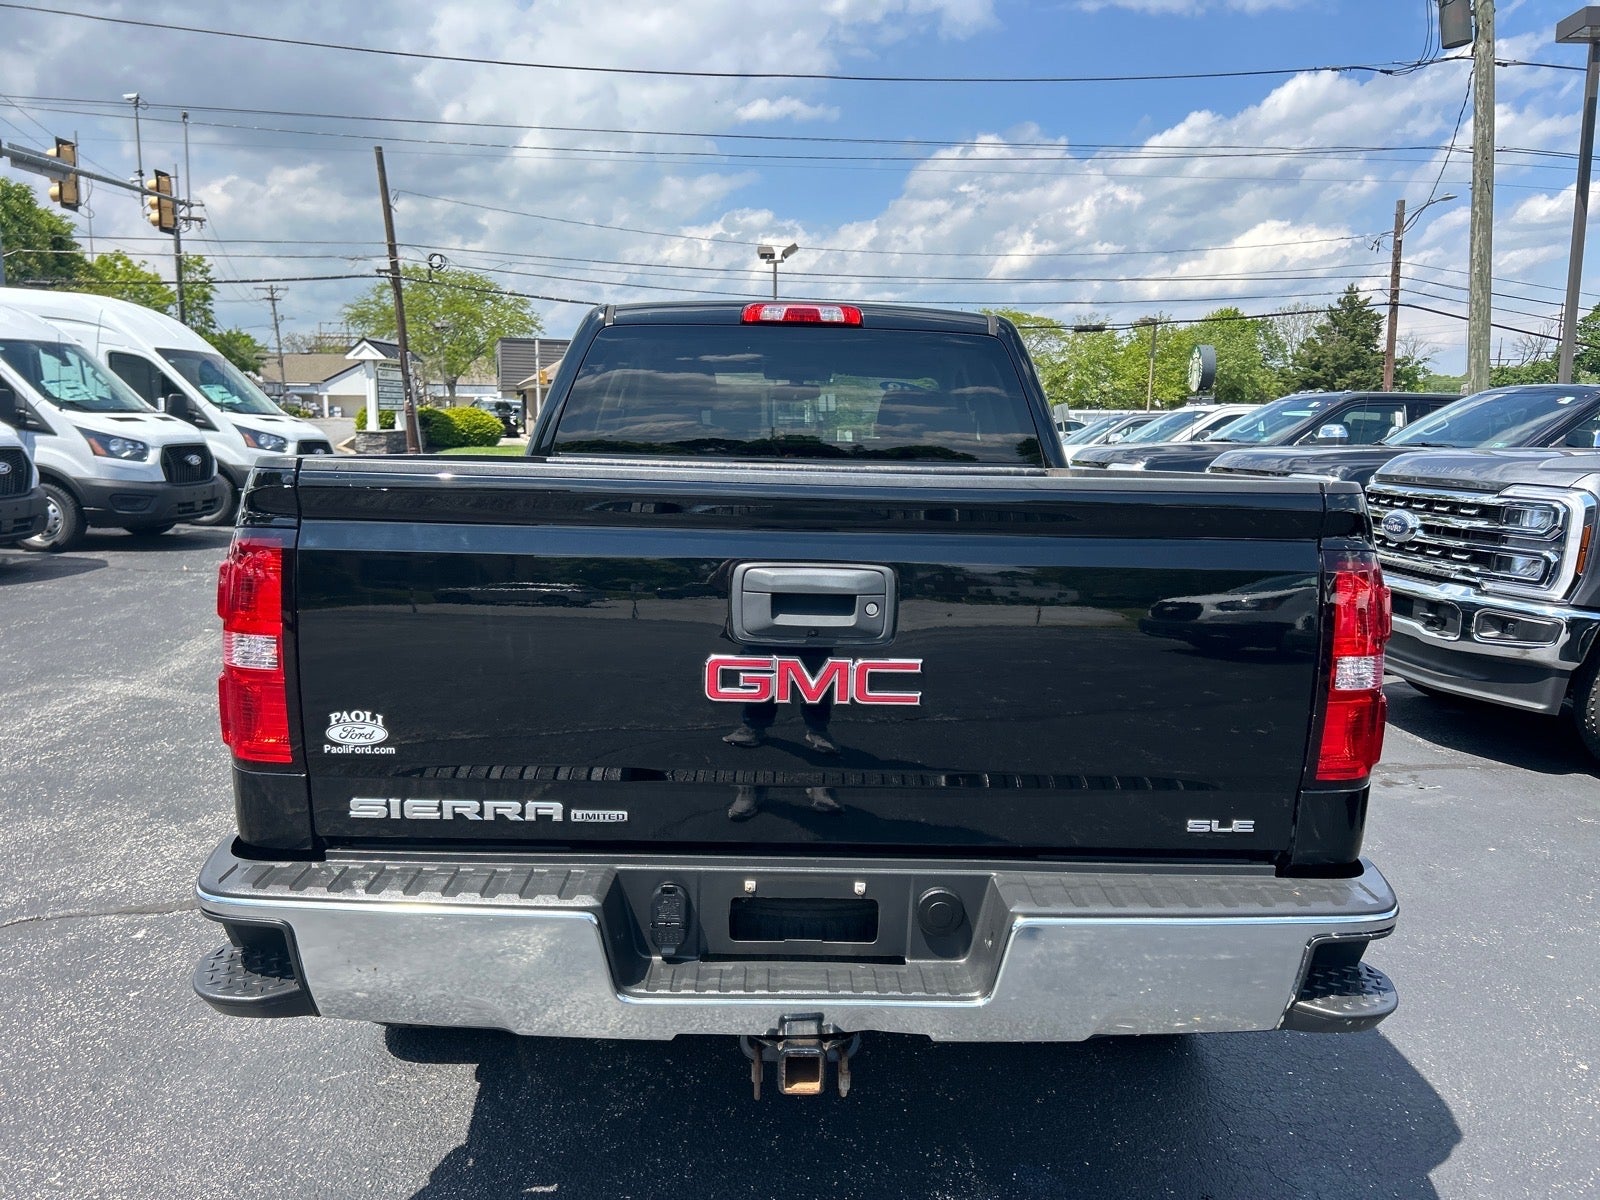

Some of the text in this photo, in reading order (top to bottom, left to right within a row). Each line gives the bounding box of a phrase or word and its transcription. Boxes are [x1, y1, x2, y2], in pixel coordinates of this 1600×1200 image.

[704, 653, 923, 706] GMC
[328, 710, 384, 727] PAOLI
[338, 725, 376, 740] Ford
[323, 744, 396, 755] PaoliFord.com
[349, 798, 625, 822] SIERRA LIMITED
[1187, 819, 1255, 832] SLE
